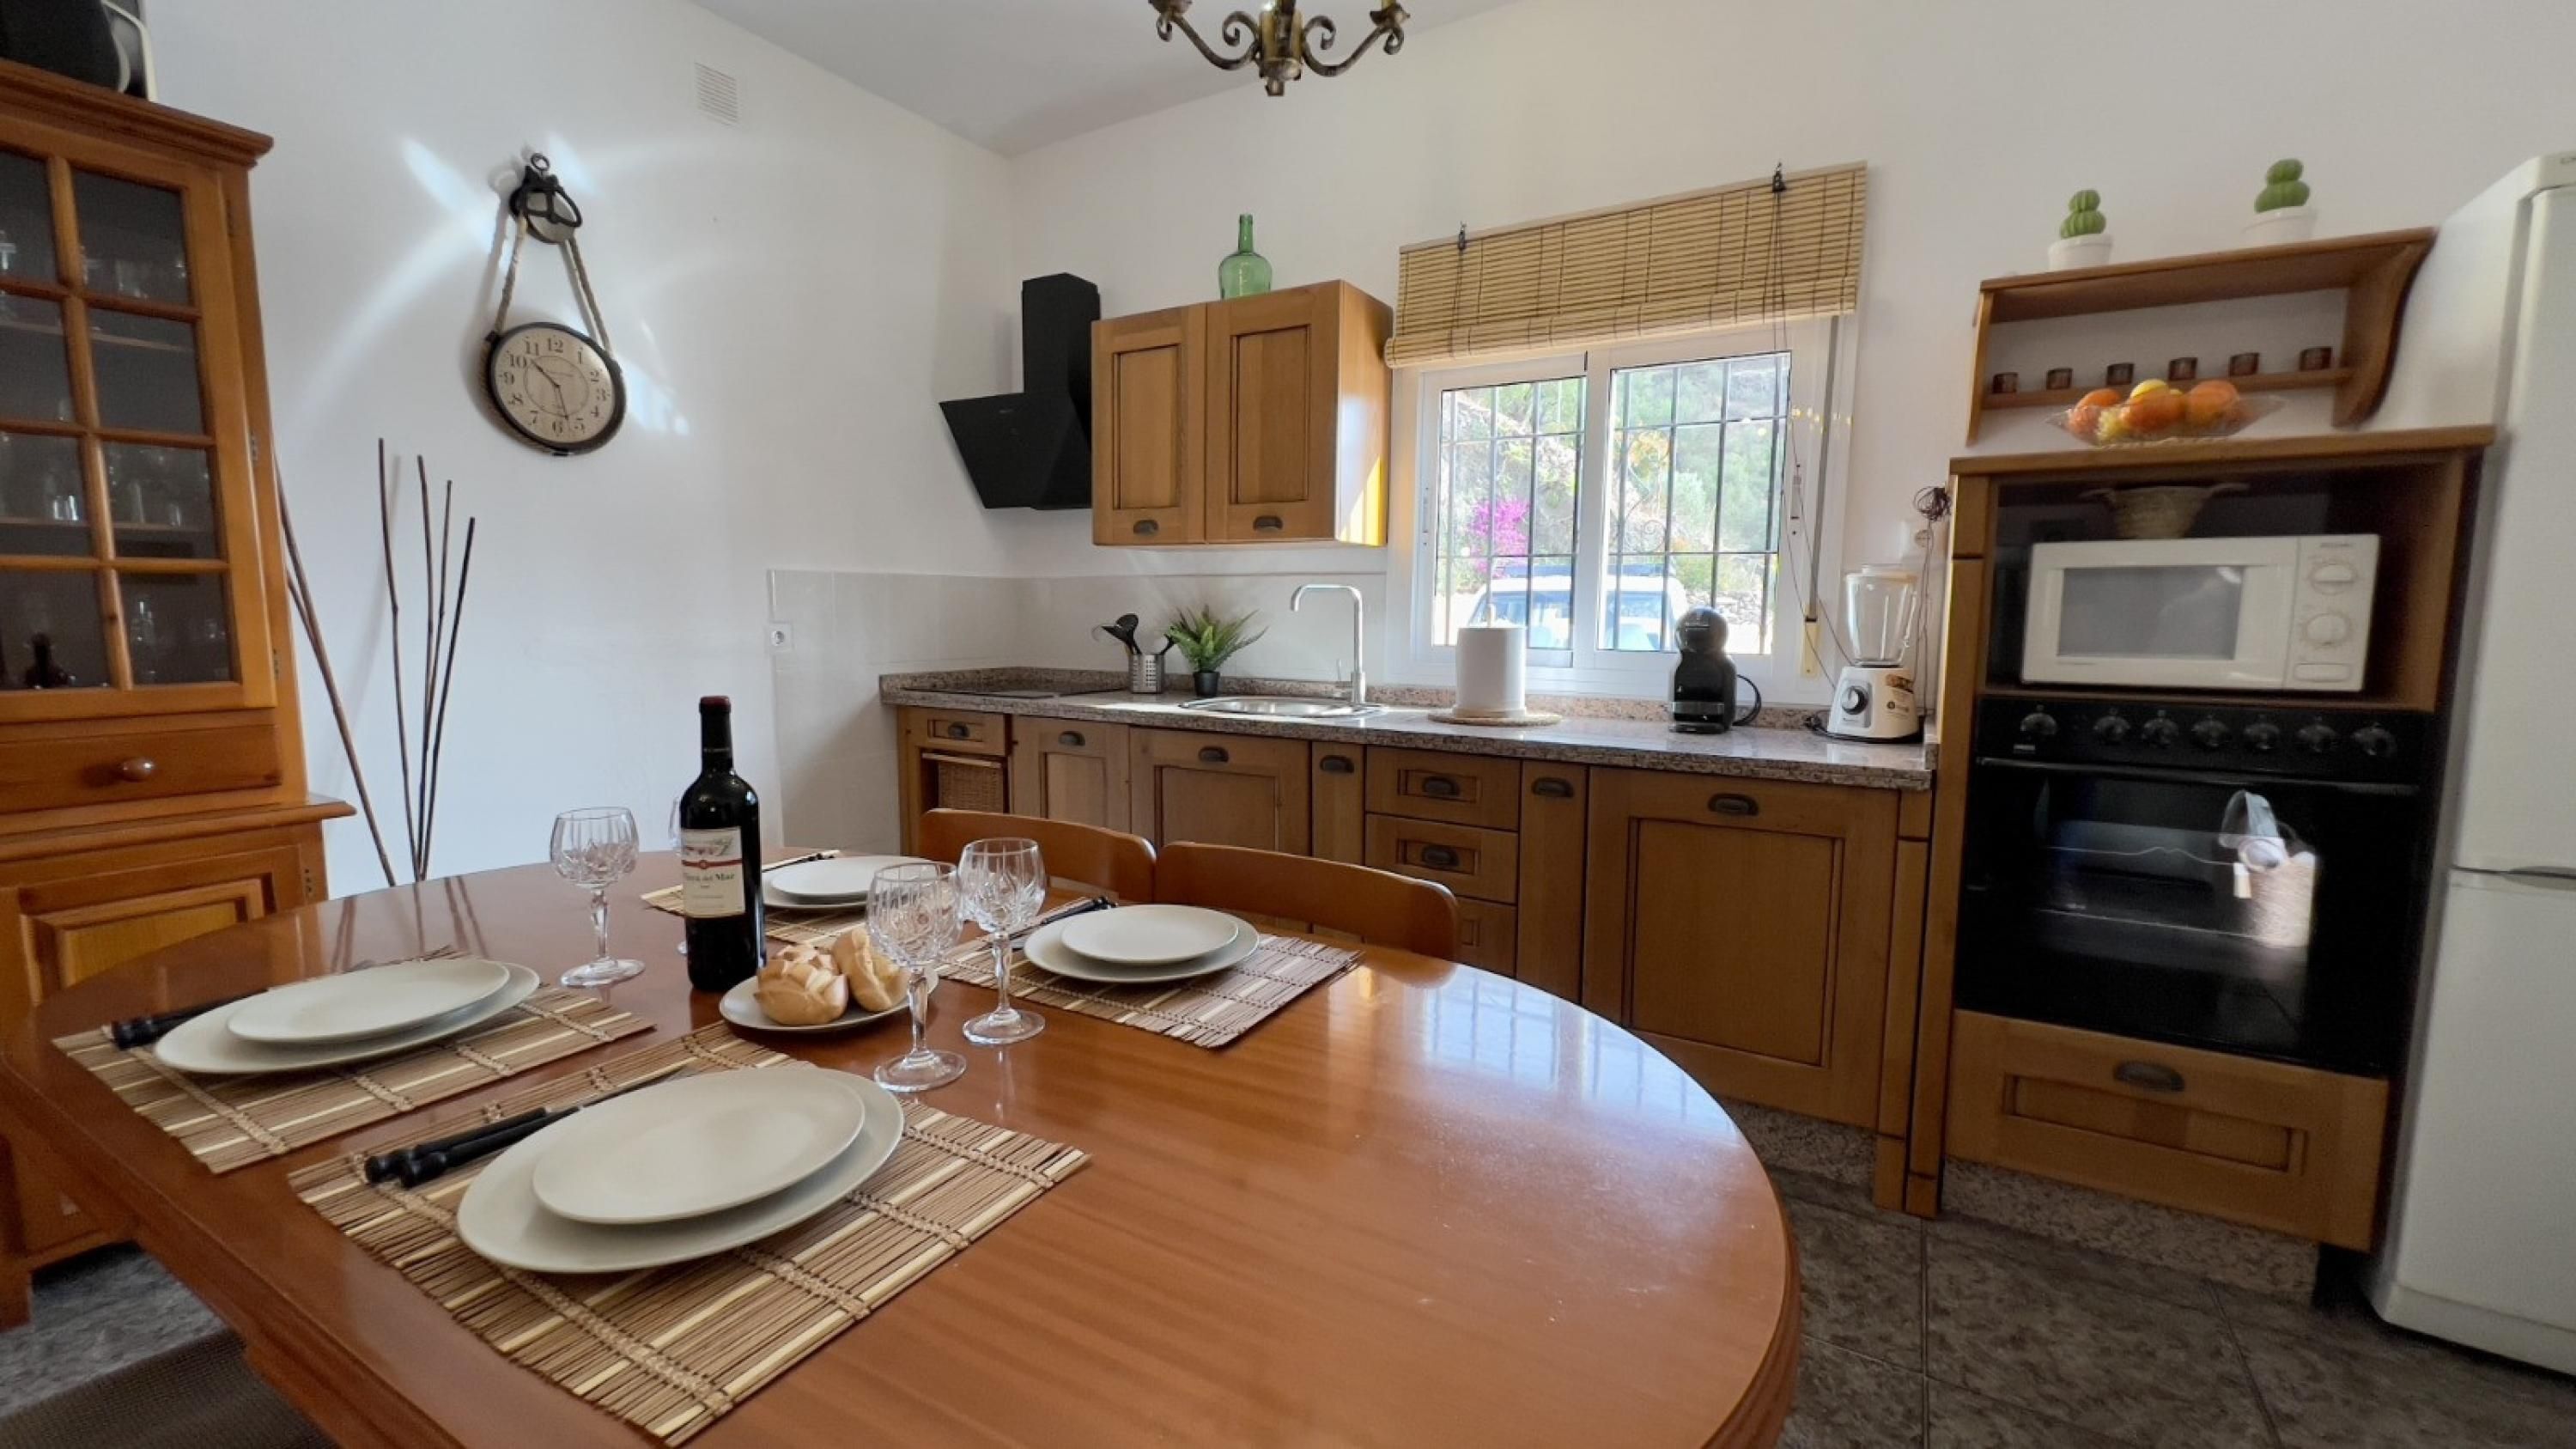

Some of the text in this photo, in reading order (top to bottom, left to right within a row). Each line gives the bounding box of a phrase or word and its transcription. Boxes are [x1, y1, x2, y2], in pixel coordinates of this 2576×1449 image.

[526, 341, 539, 356] 11
[548, 337, 563, 353] 12
[510, 354, 527, 368] 10
[577, 350, 583, 364] 1
[503, 371, 514, 385] 9
[590, 369, 599, 382] 2
[528, 410, 538, 425] 7
[591, 405, 599, 417] 4
[552, 421, 564, 434] 6
[574, 417, 586, 432] 5
